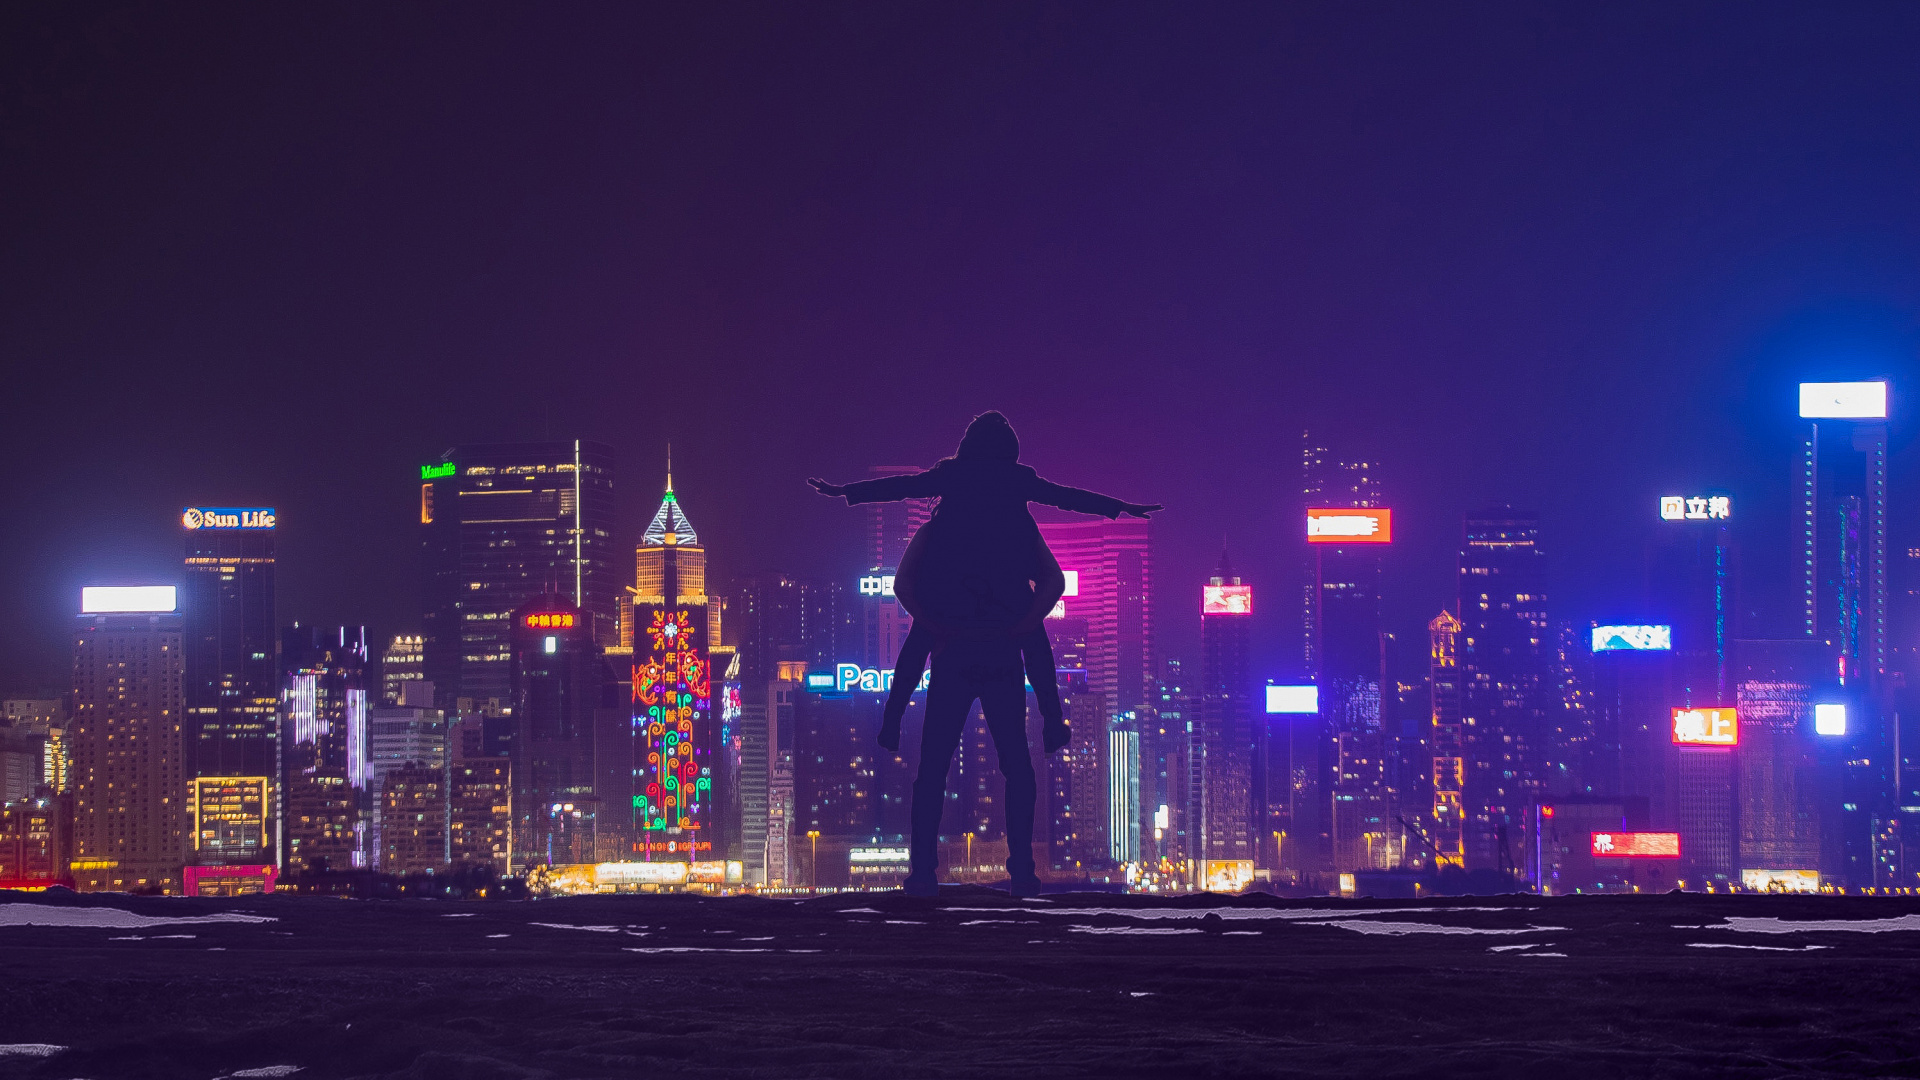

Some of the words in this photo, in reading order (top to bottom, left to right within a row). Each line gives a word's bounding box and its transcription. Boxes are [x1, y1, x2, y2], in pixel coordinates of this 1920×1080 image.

[421, 462, 456, 479] Manulife
[204, 511, 239, 527] Sun
[241, 510, 276, 527] Life
